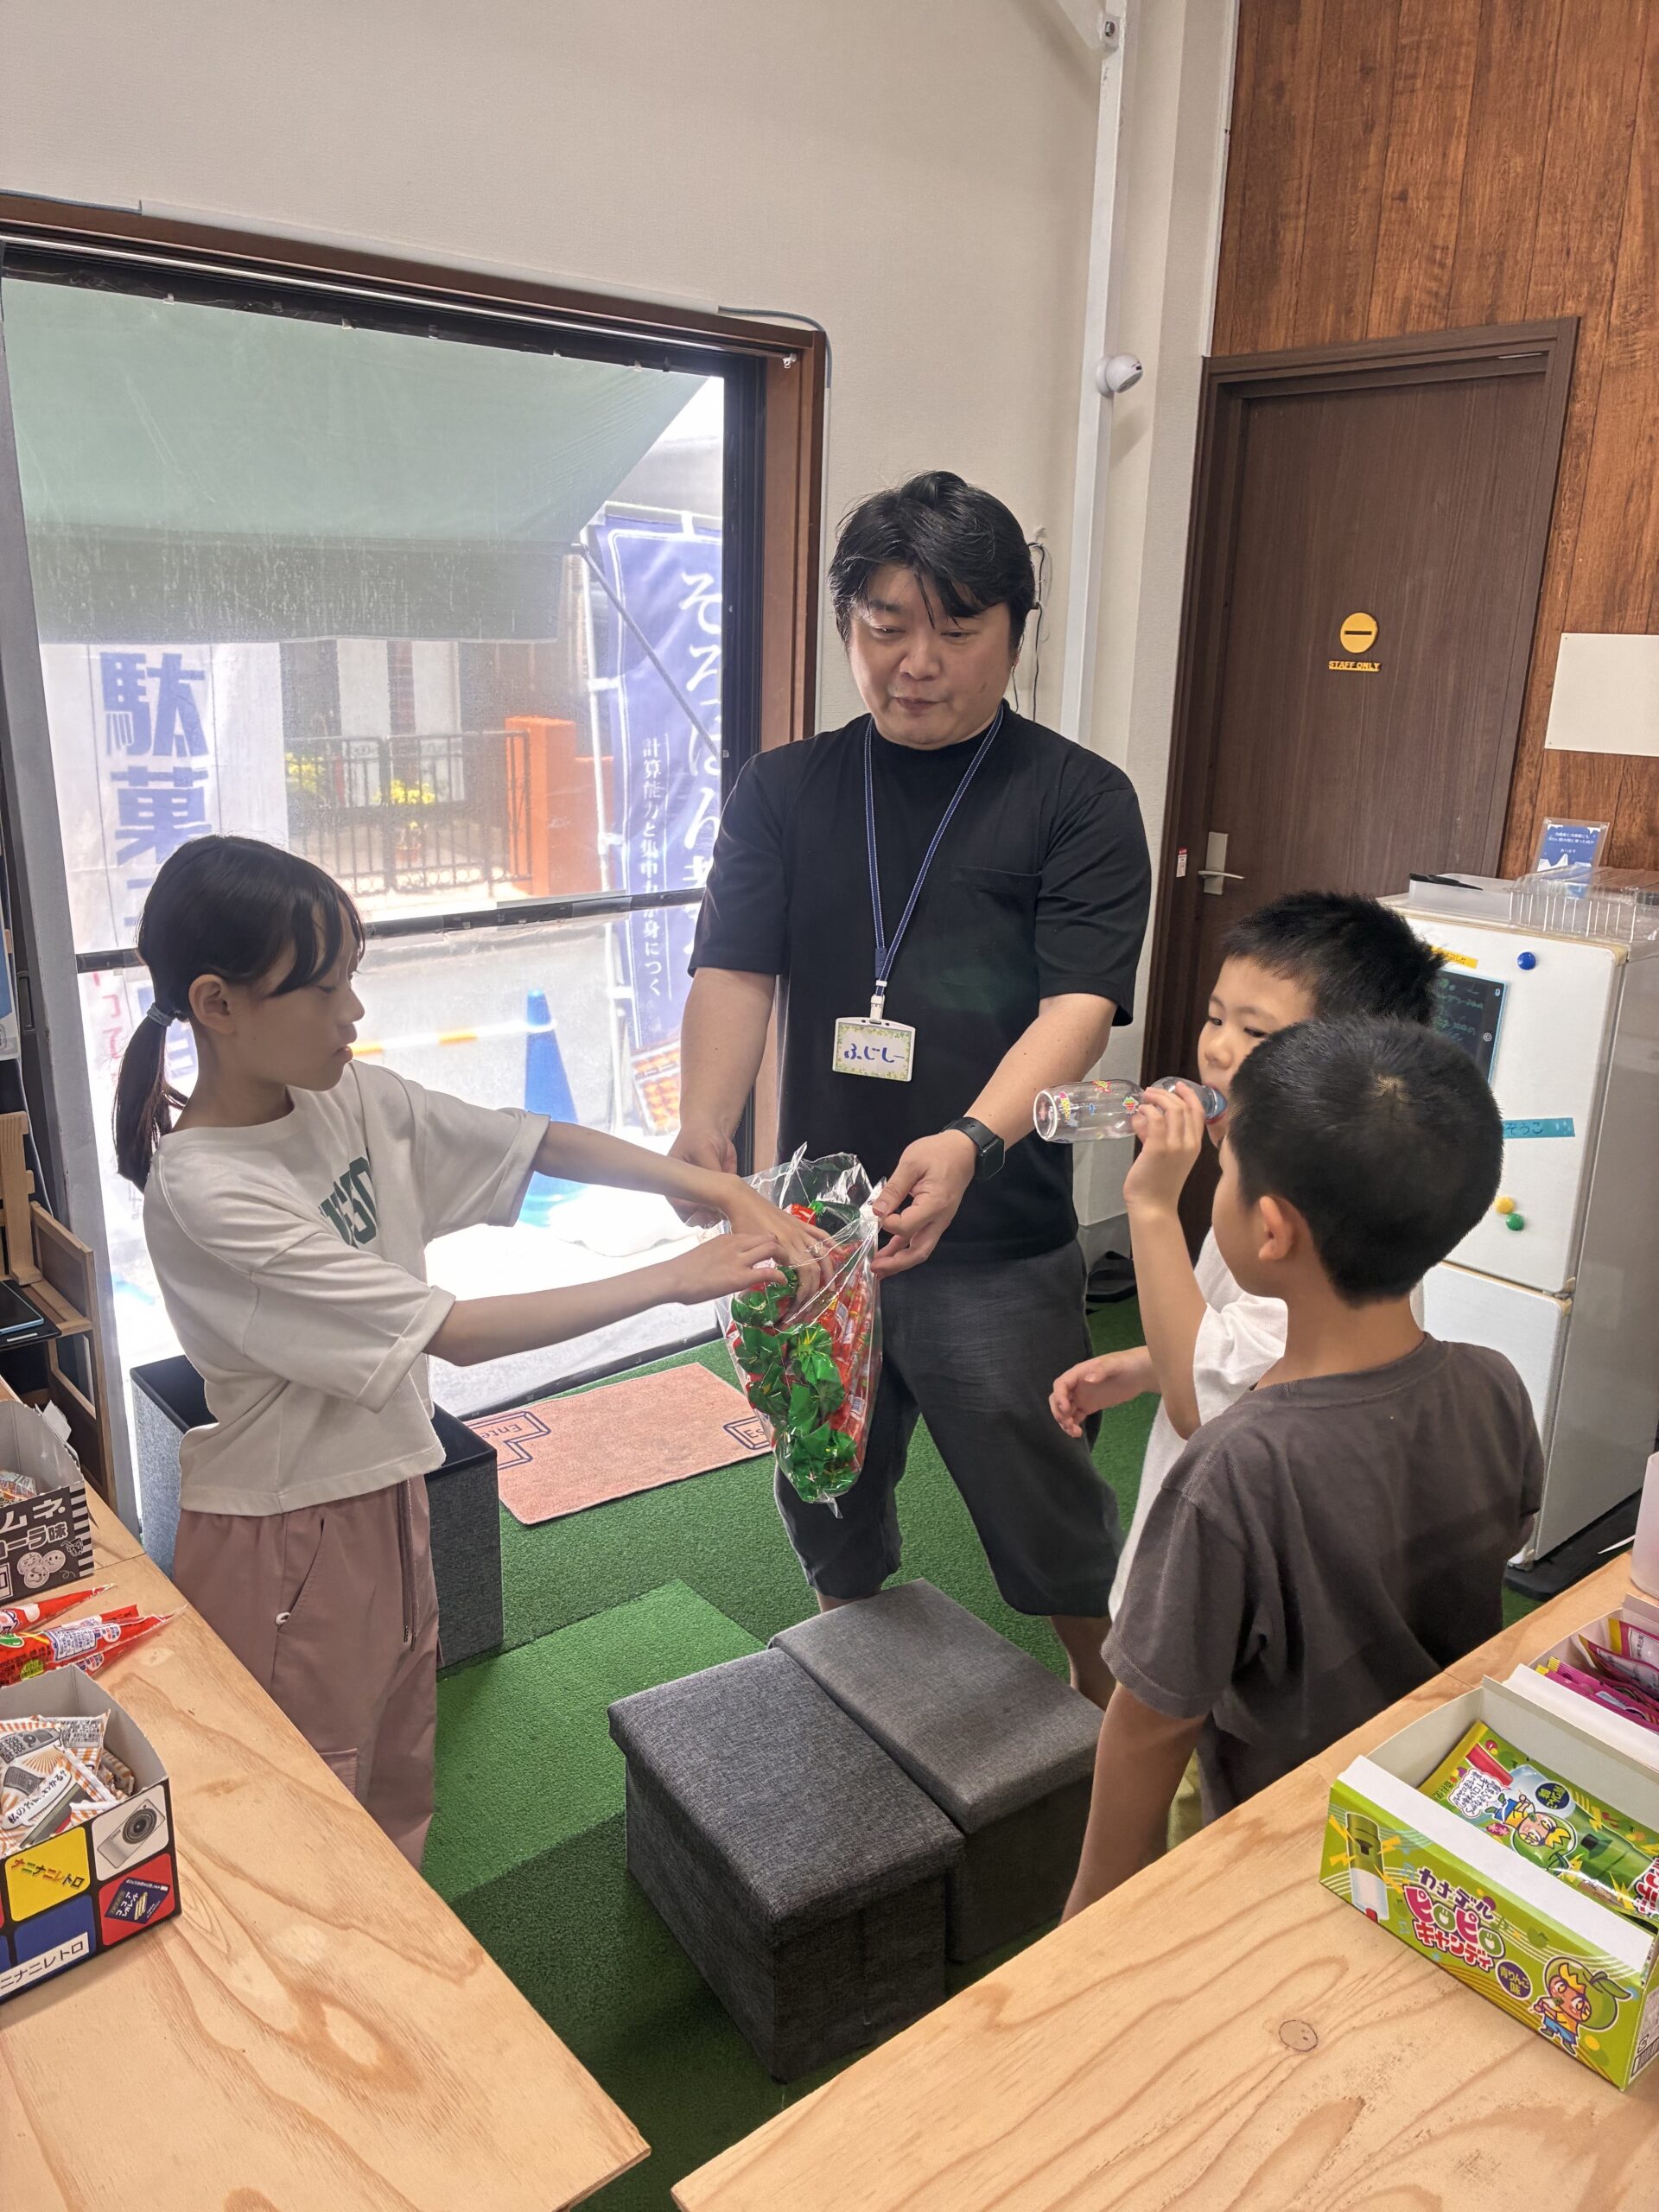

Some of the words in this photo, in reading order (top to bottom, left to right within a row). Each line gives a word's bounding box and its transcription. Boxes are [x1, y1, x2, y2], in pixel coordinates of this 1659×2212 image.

[1329, 660, 1356, 669] STAFF
[1357, 662, 1381, 671] ONLY
[480, 1422, 524, 1440] Ente
[11, 1859, 85, 1890] ナニナニレトロ
[1418, 1867, 1494, 1921] カナデル
[1404, 1885, 1505, 1958] ピロピロ
[1414, 1921, 1495, 1973] キャンディ
[1499, 1965, 1530, 1990] 青りんご
[1509, 1982, 1522, 1997] 味
